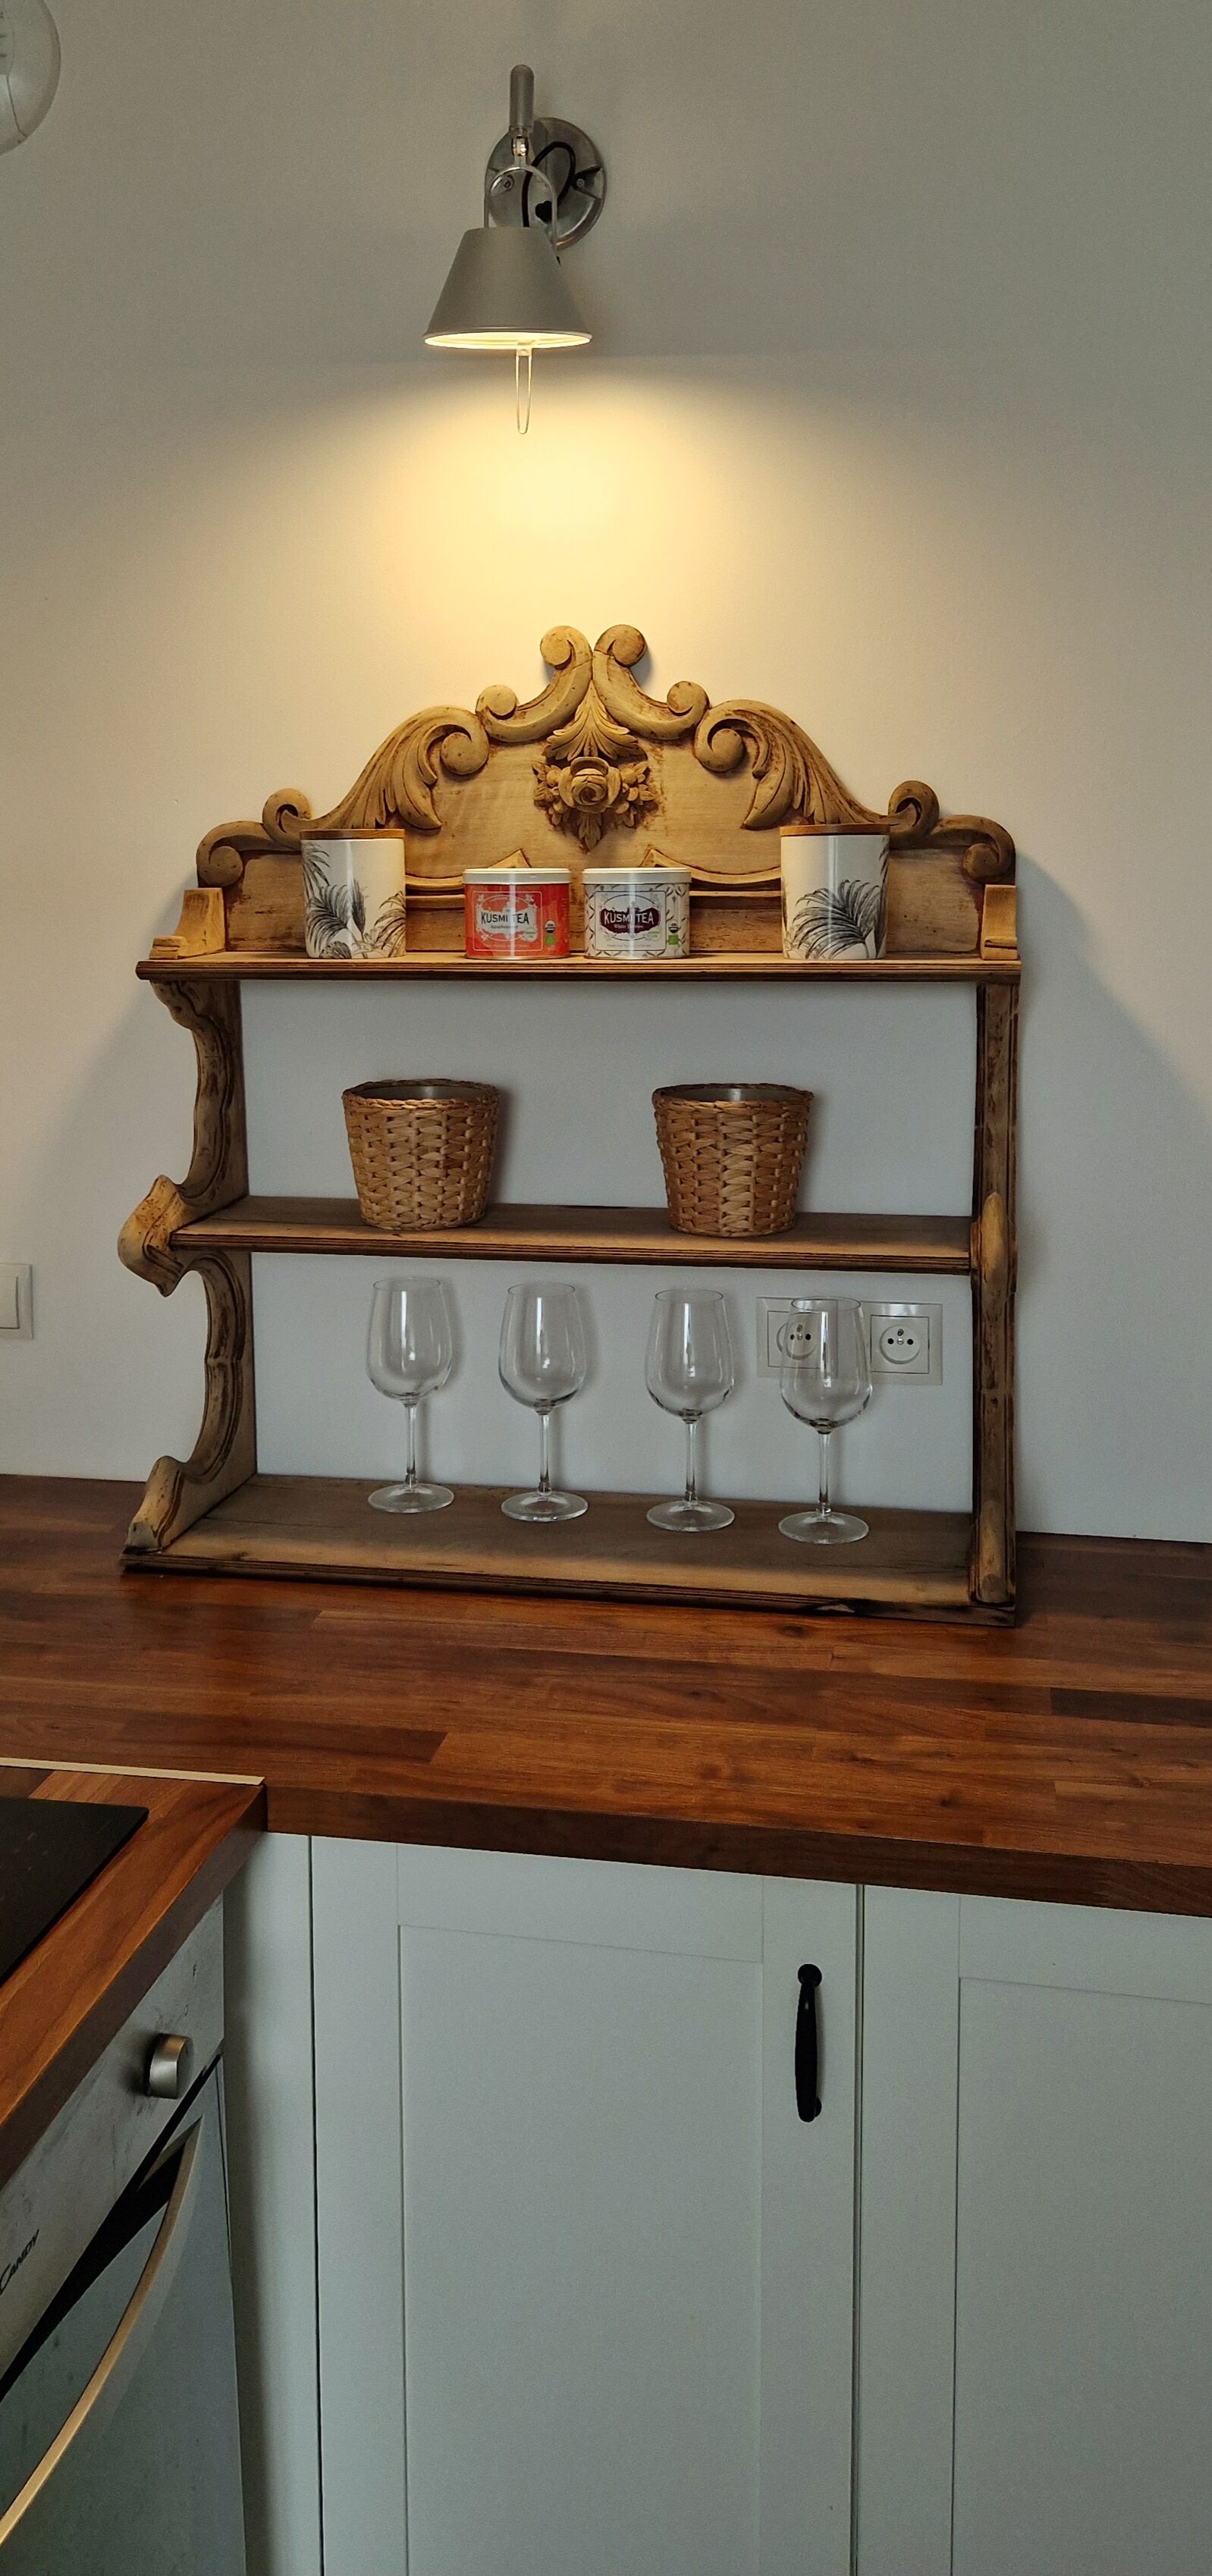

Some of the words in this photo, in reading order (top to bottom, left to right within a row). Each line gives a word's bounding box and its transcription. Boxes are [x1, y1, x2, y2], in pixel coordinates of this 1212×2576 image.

[481, 911, 508, 924] KUSMI
[604, 911, 633, 925] KUSMI
[636, 911, 655, 925] TEA
